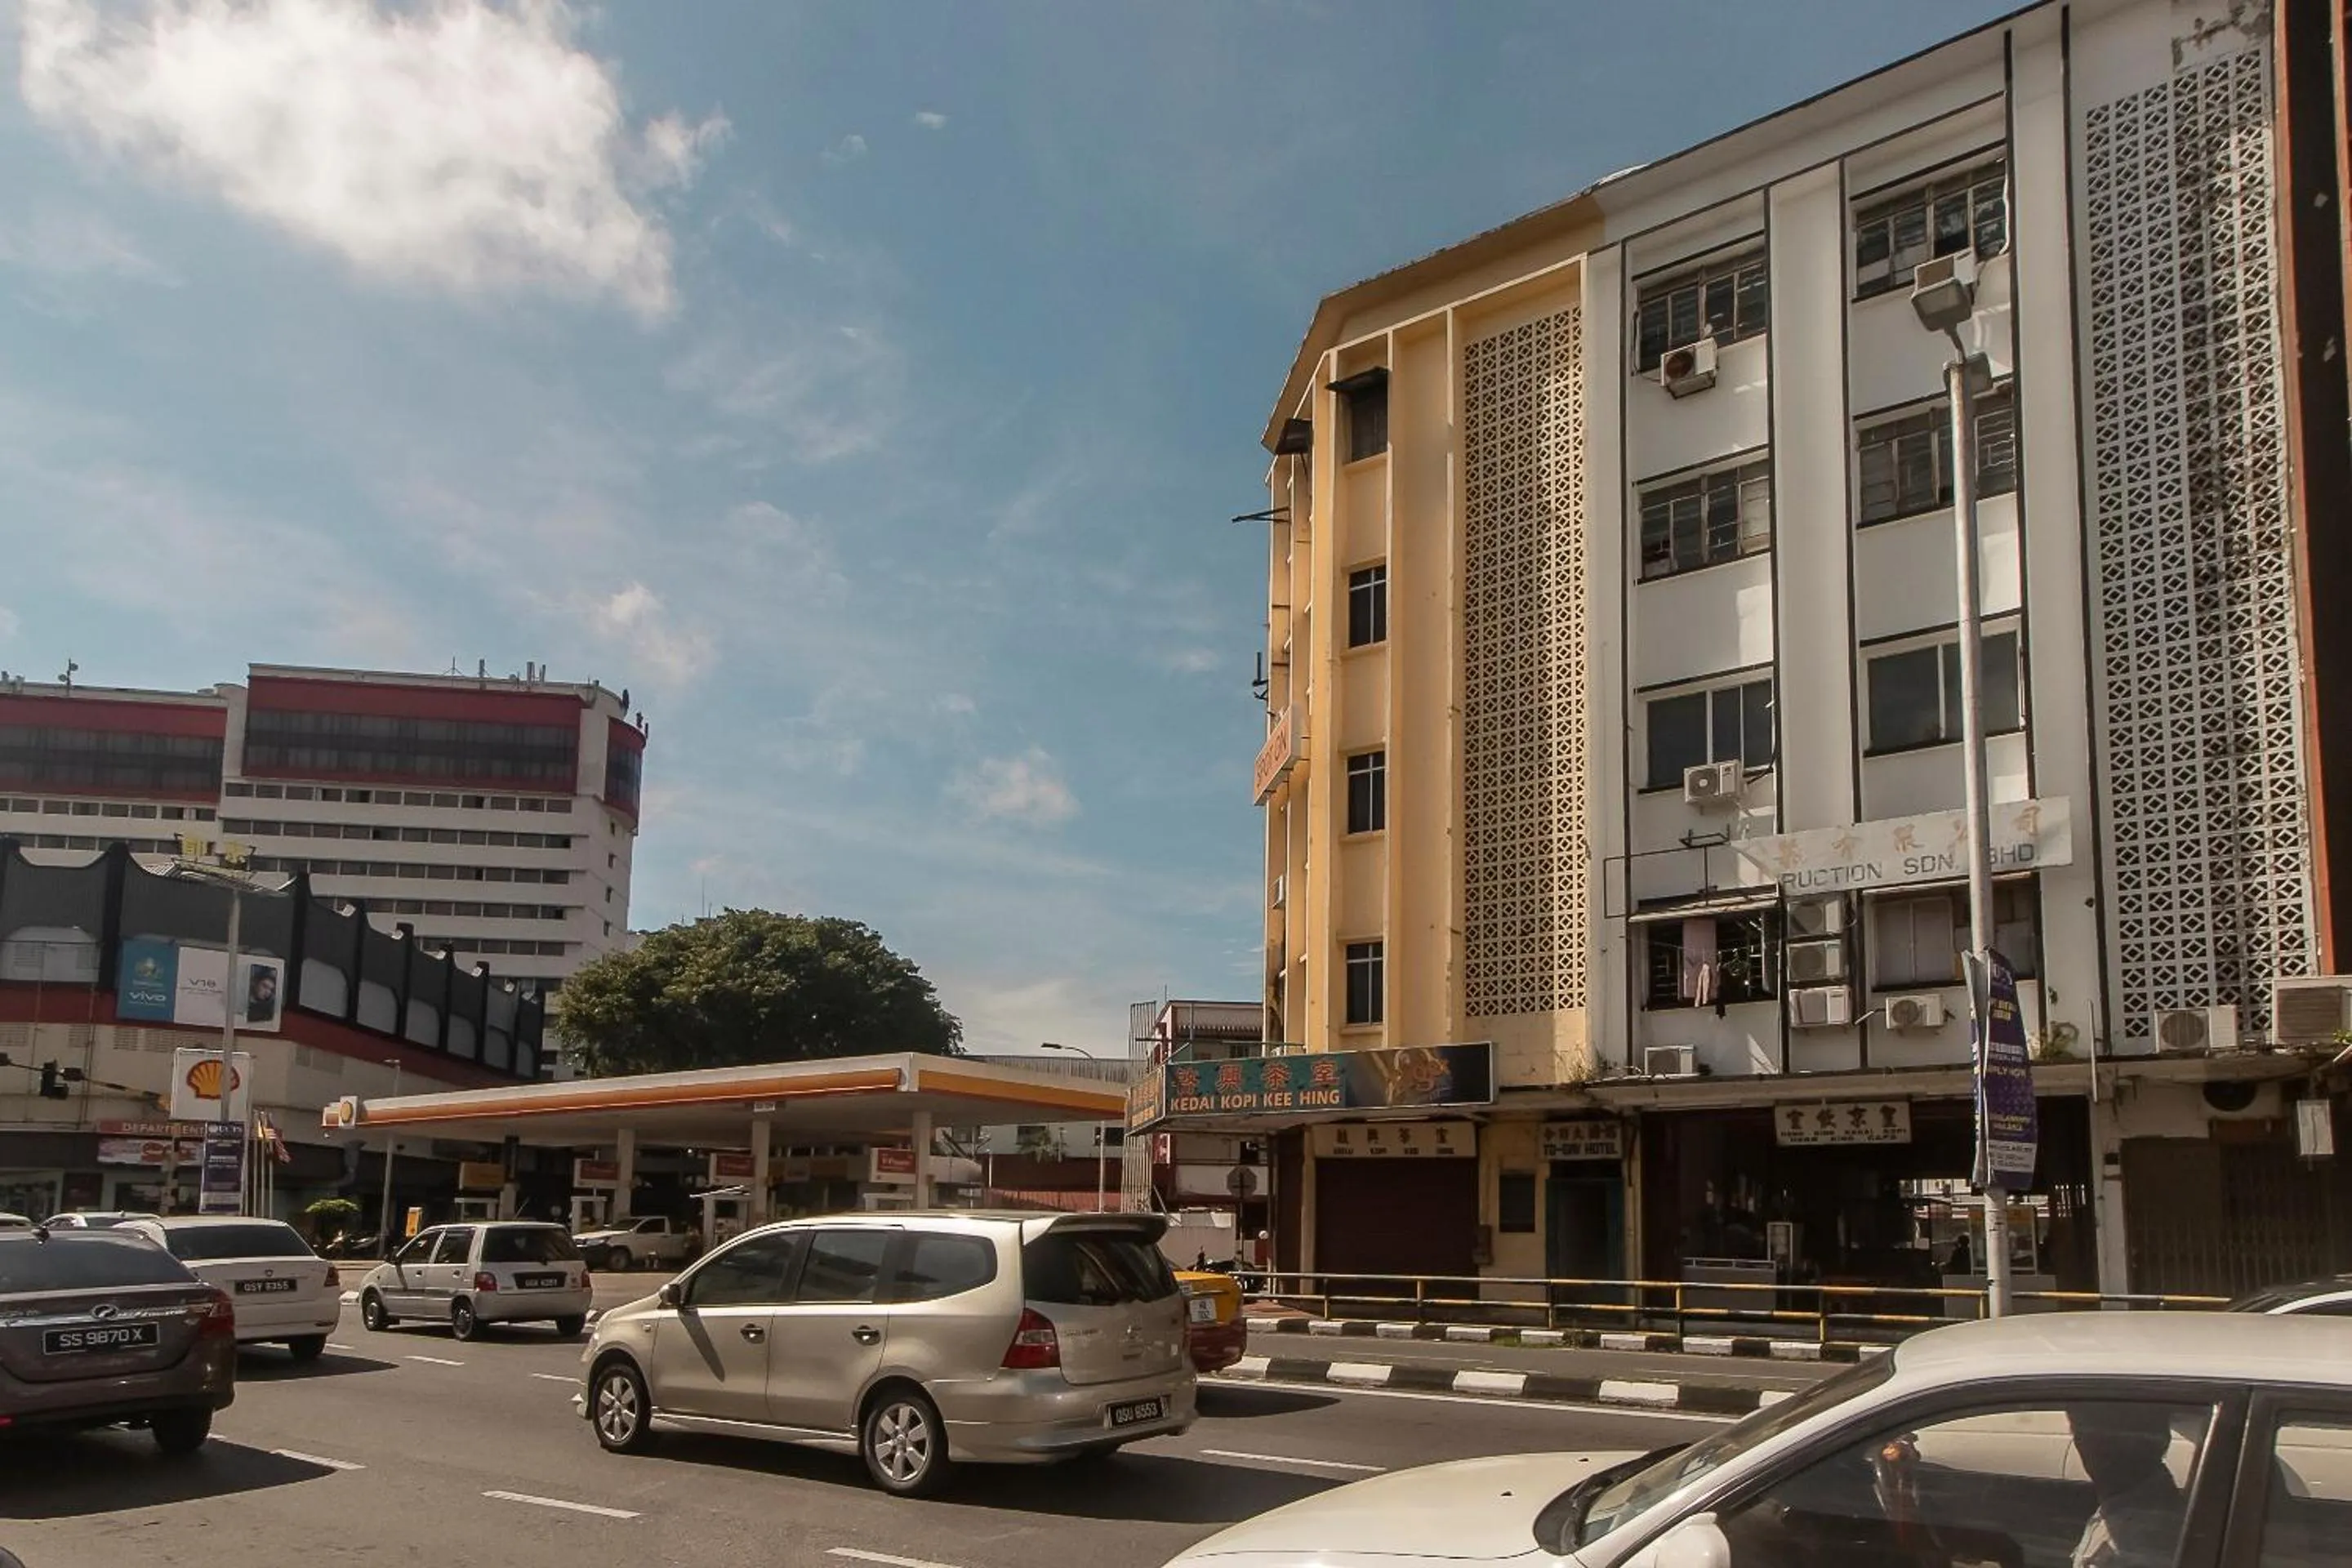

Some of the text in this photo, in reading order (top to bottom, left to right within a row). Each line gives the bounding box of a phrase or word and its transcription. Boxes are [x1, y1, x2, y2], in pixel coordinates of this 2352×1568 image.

[1171, 1089, 1340, 1111] KEDAI KOPI KEE HING
[1584, 1141, 1619, 1156] HOTEL
[60, 1328, 143, 1348] SS 9870 X
